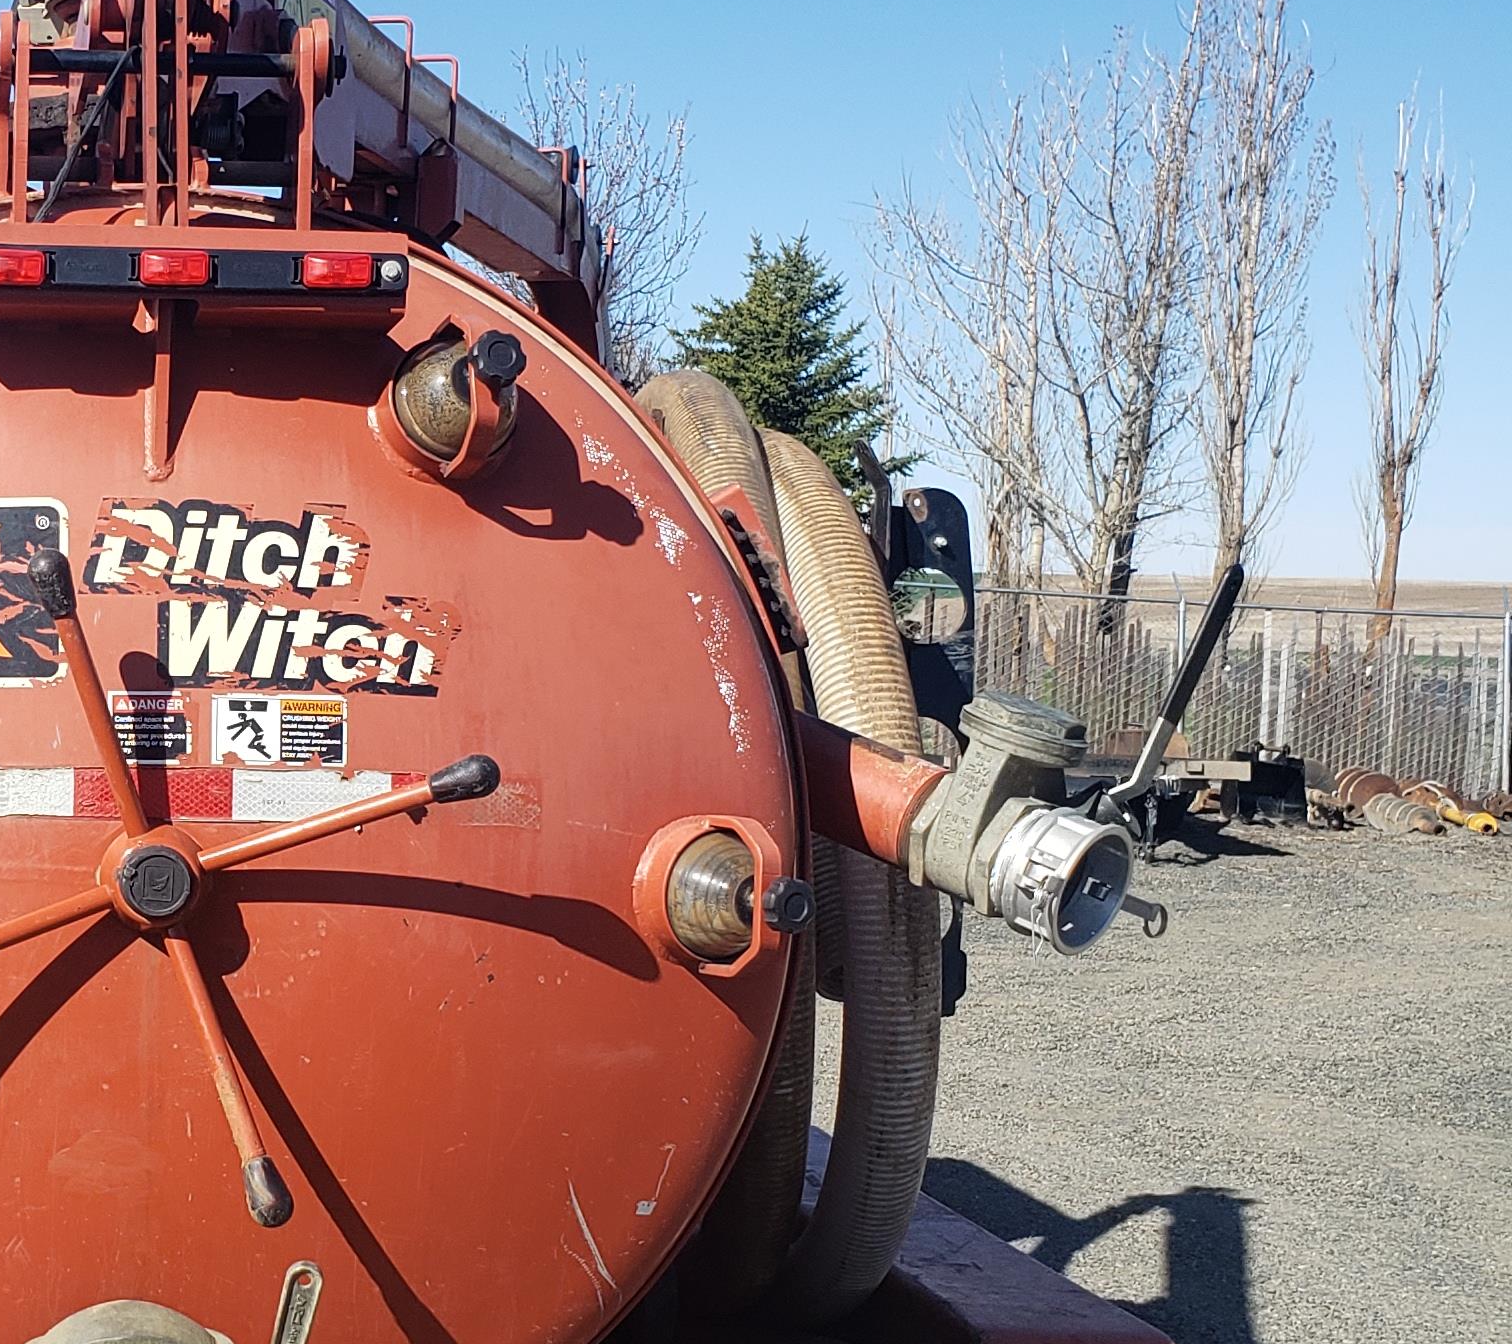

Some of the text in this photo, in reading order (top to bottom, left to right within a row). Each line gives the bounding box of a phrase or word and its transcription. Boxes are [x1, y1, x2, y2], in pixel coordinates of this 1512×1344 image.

[93, 508, 360, 589] Ditch
[128, 698, 184, 711] DANGER
[291, 702, 341, 713] WARNING
